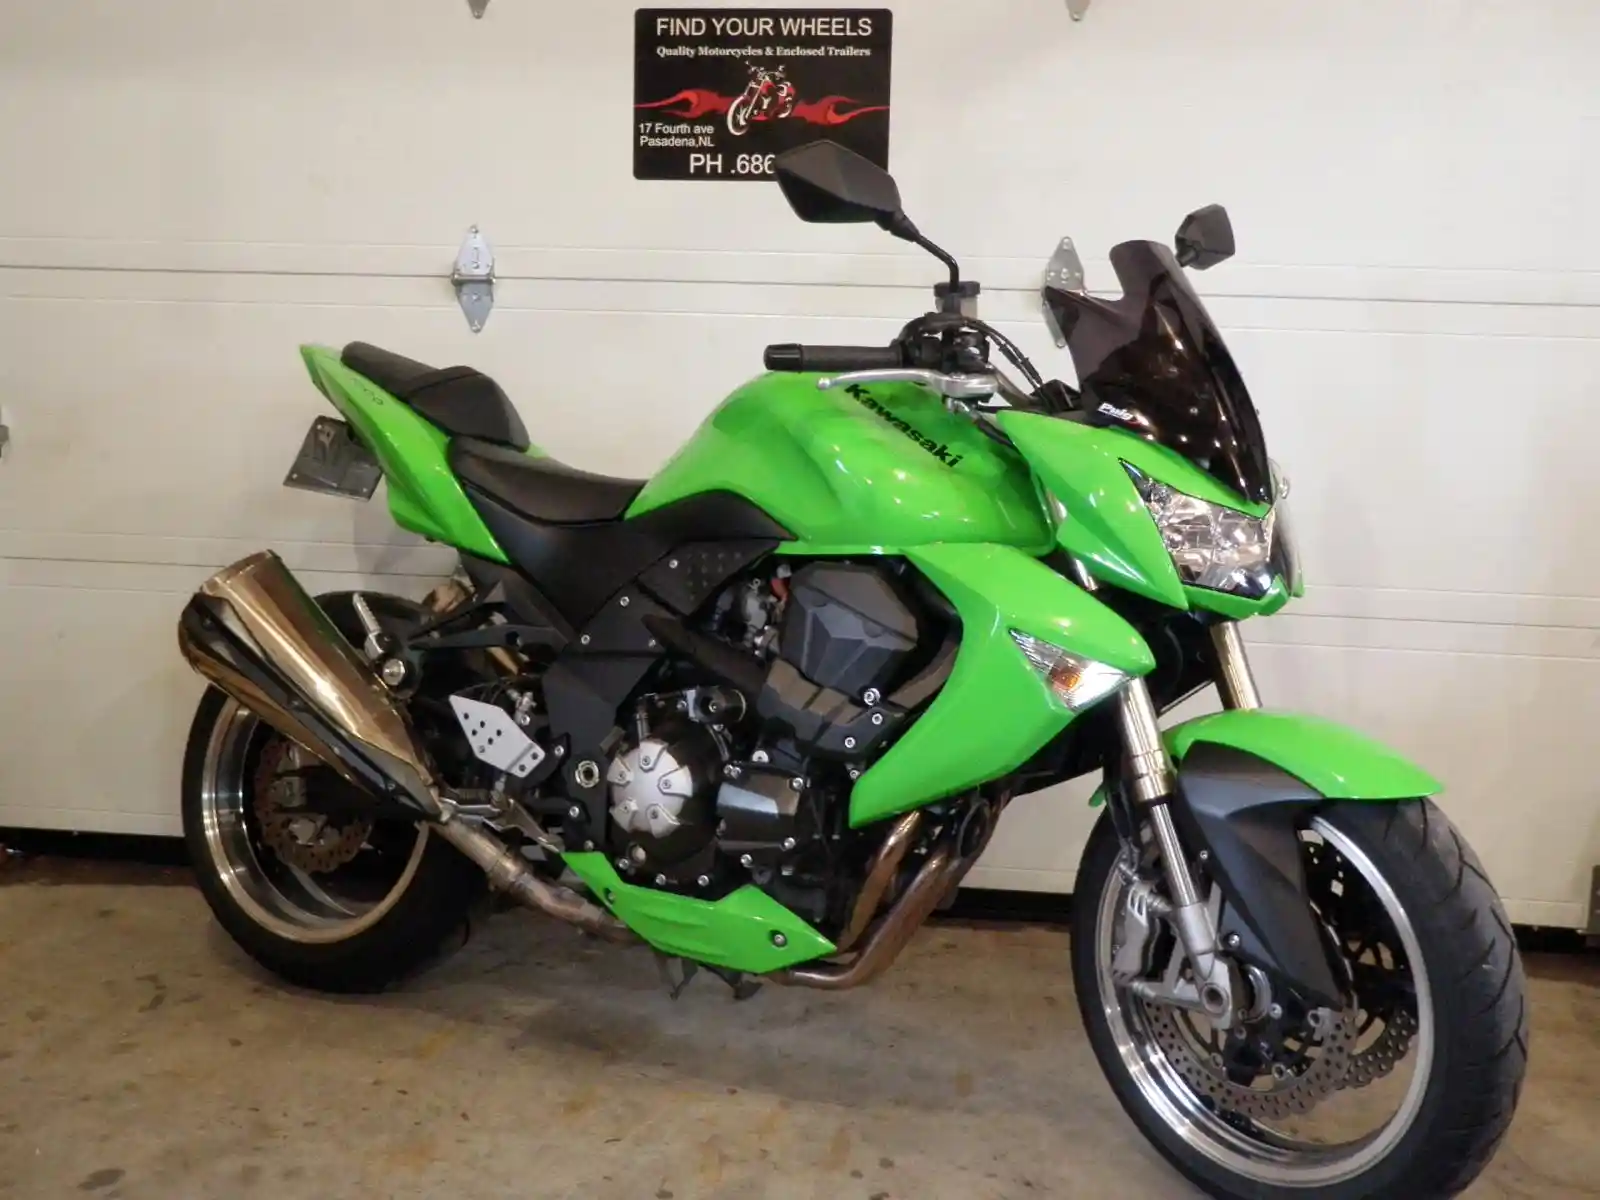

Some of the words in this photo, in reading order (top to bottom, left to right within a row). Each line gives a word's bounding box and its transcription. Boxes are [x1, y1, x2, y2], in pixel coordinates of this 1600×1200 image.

[656, 18, 706, 36] FIND
[712, 18, 774, 36] YOUR
[780, 18, 872, 36] WHEELS
[656, 46, 695, 58] Quality
[698, 46, 763, 57] Motorcycles
[765, 47, 773, 56] &
[776, 46, 825, 56] Enclosed
[827, 46, 871, 56] Trailers
[639, 124, 651, 134] 17
[655, 124, 690, 134] Fourth
[693, 126, 714, 134] ave
[640, 136, 714, 147] Pasadena,NL
[690, 154, 722, 174] PH
[845, 384, 963, 467] Kawasaki
